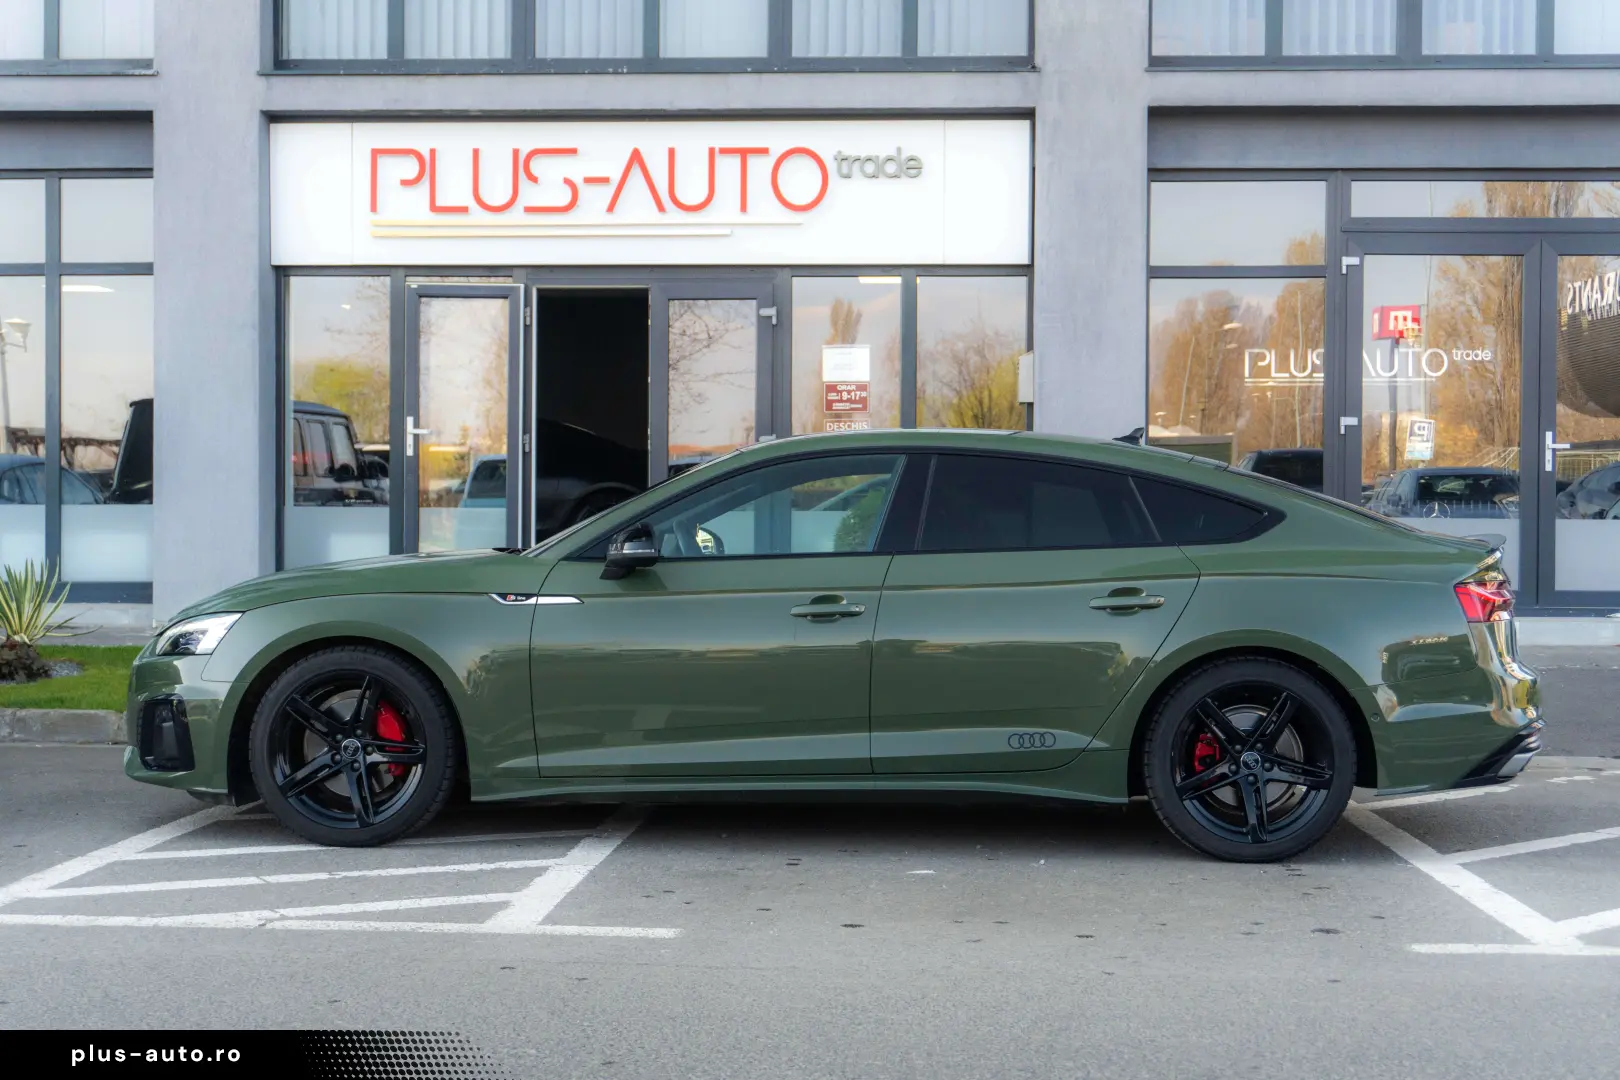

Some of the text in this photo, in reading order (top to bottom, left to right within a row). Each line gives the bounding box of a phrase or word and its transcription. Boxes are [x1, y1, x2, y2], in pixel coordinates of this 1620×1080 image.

[371, 146, 923, 213] PLUS-AUTO trade
[1452, 347, 1492, 361] trade
[826, 421, 868, 431] DESCHIS
